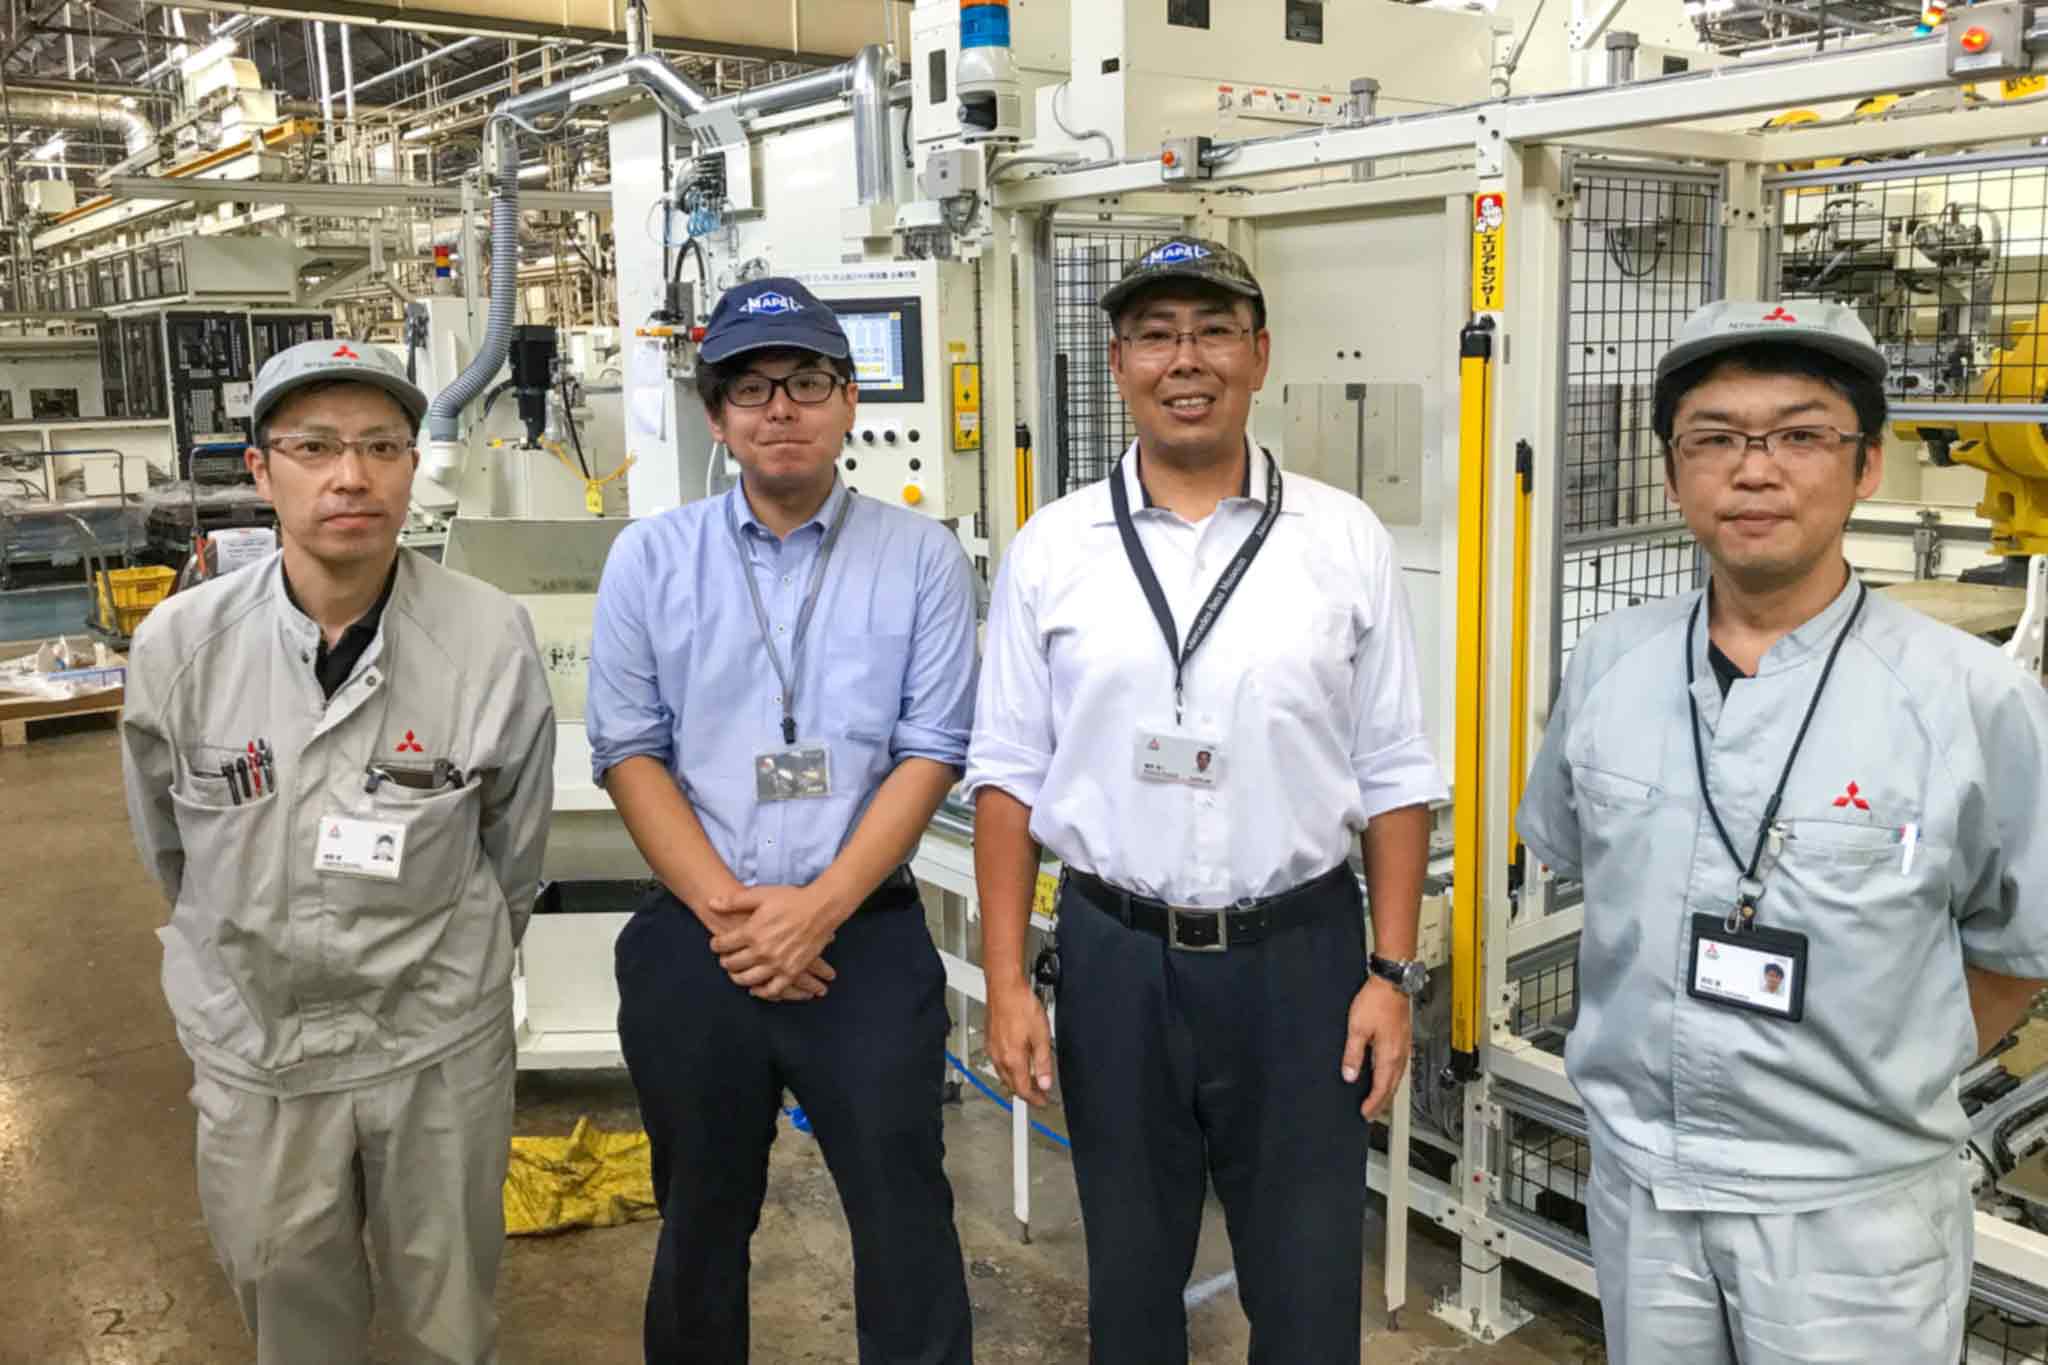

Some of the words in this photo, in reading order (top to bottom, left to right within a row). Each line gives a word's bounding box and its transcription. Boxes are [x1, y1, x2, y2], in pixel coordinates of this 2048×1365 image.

[1481, 234, 1496, 305] エリアセンサー
[745, 294, 802, 314] MAPAL
